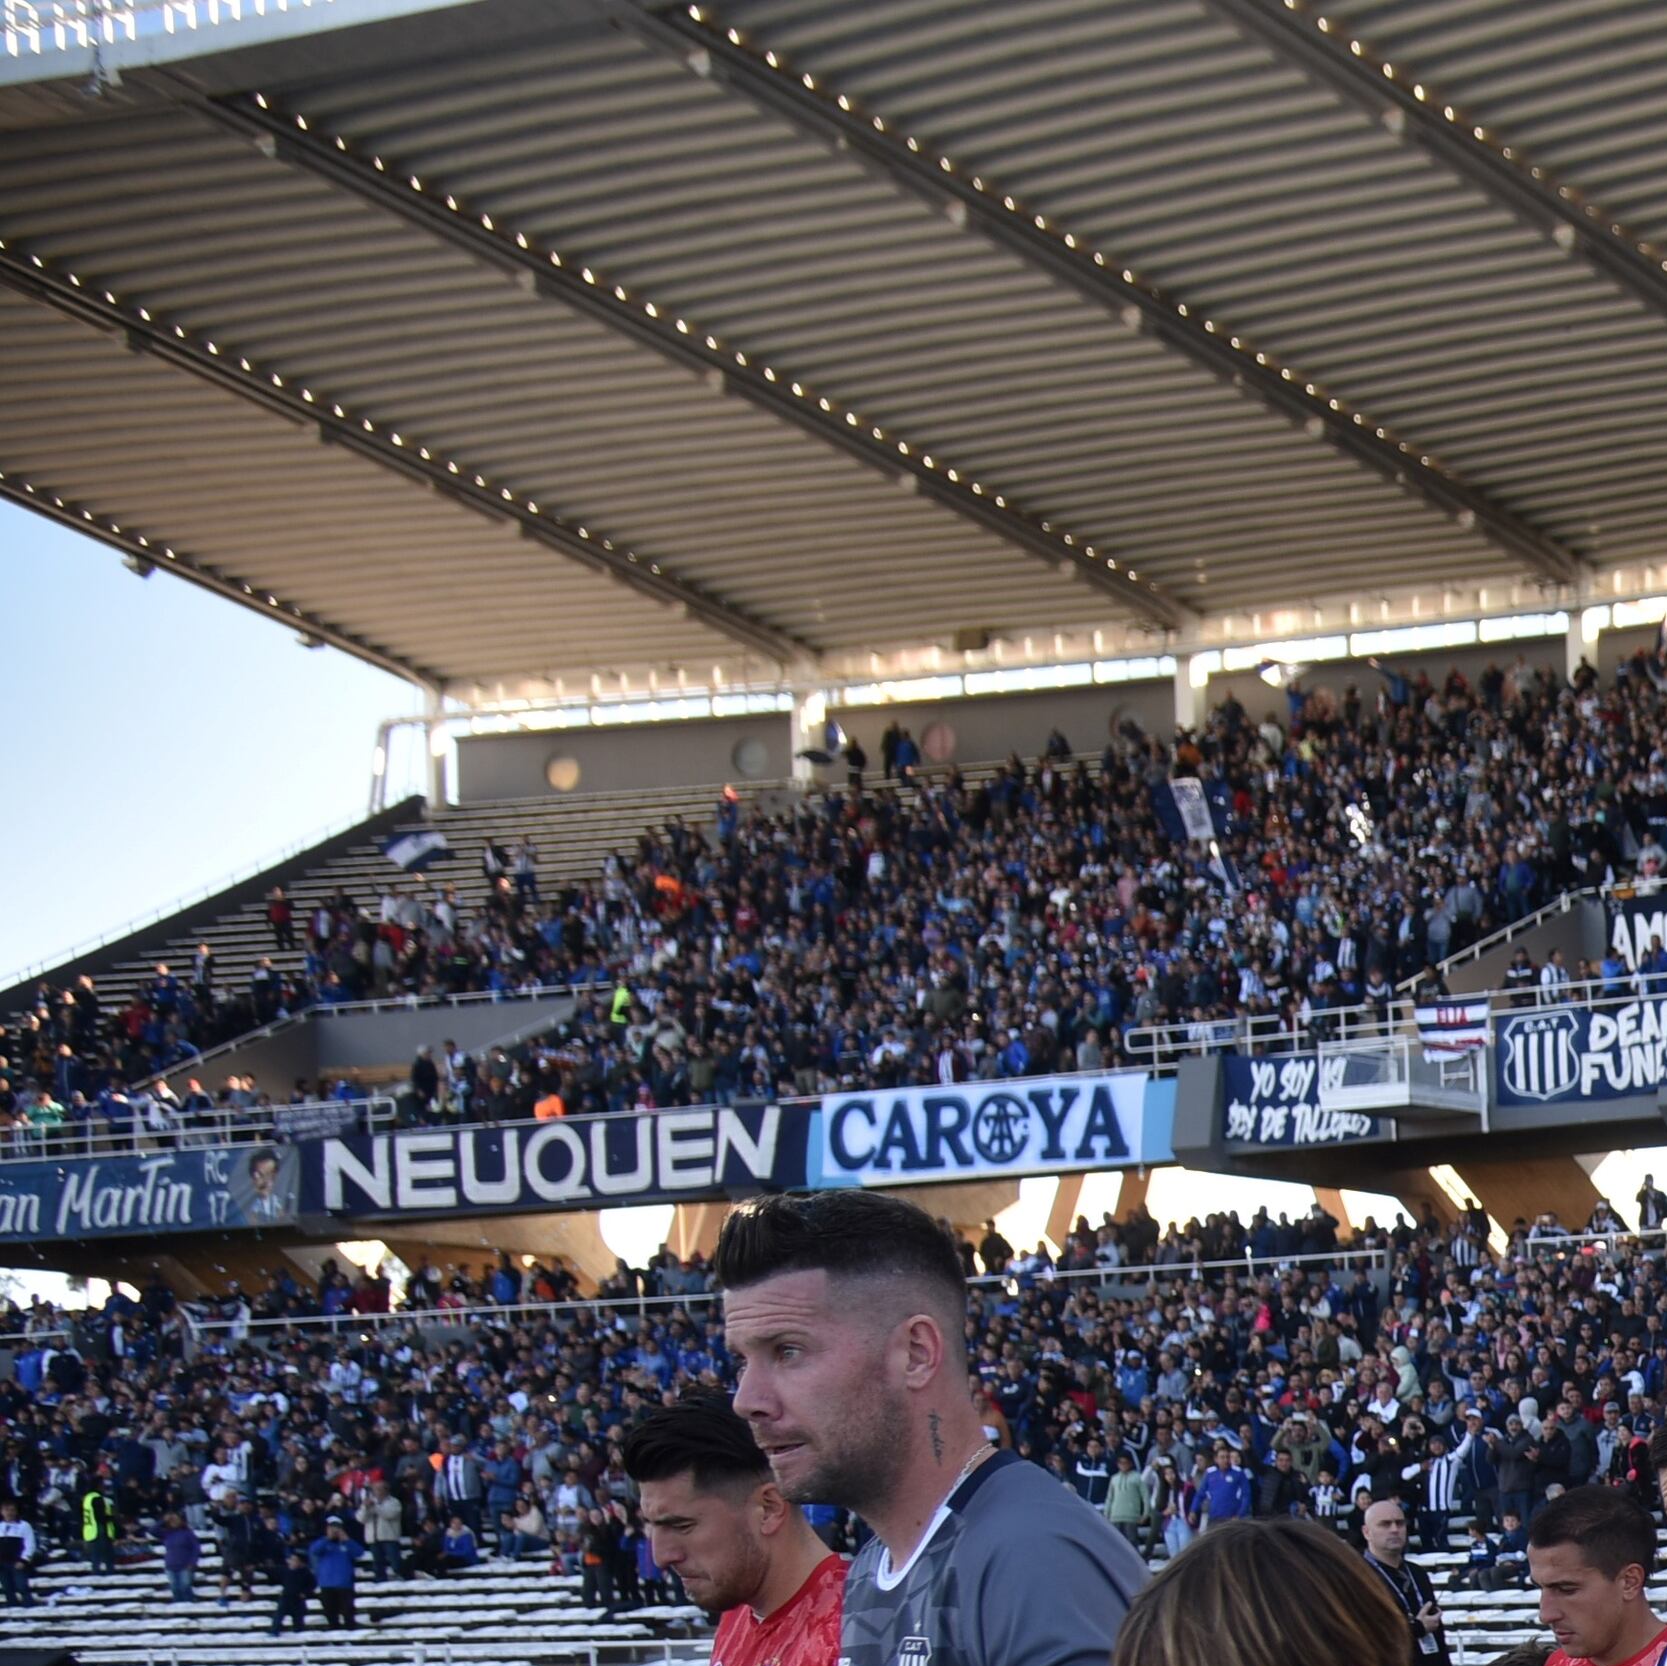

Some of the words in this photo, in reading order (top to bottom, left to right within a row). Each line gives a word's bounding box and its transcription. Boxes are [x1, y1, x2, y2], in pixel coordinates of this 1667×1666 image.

[1250, 1060, 1276, 1104] YO
[1279, 1058, 1316, 1102] SOY
[829, 1085, 1130, 1170] CAROYA
[1260, 1105, 1289, 1143] DE
[1291, 1102, 1372, 1144] TALLERES
[323, 1106, 781, 1209] NEUQUEN
